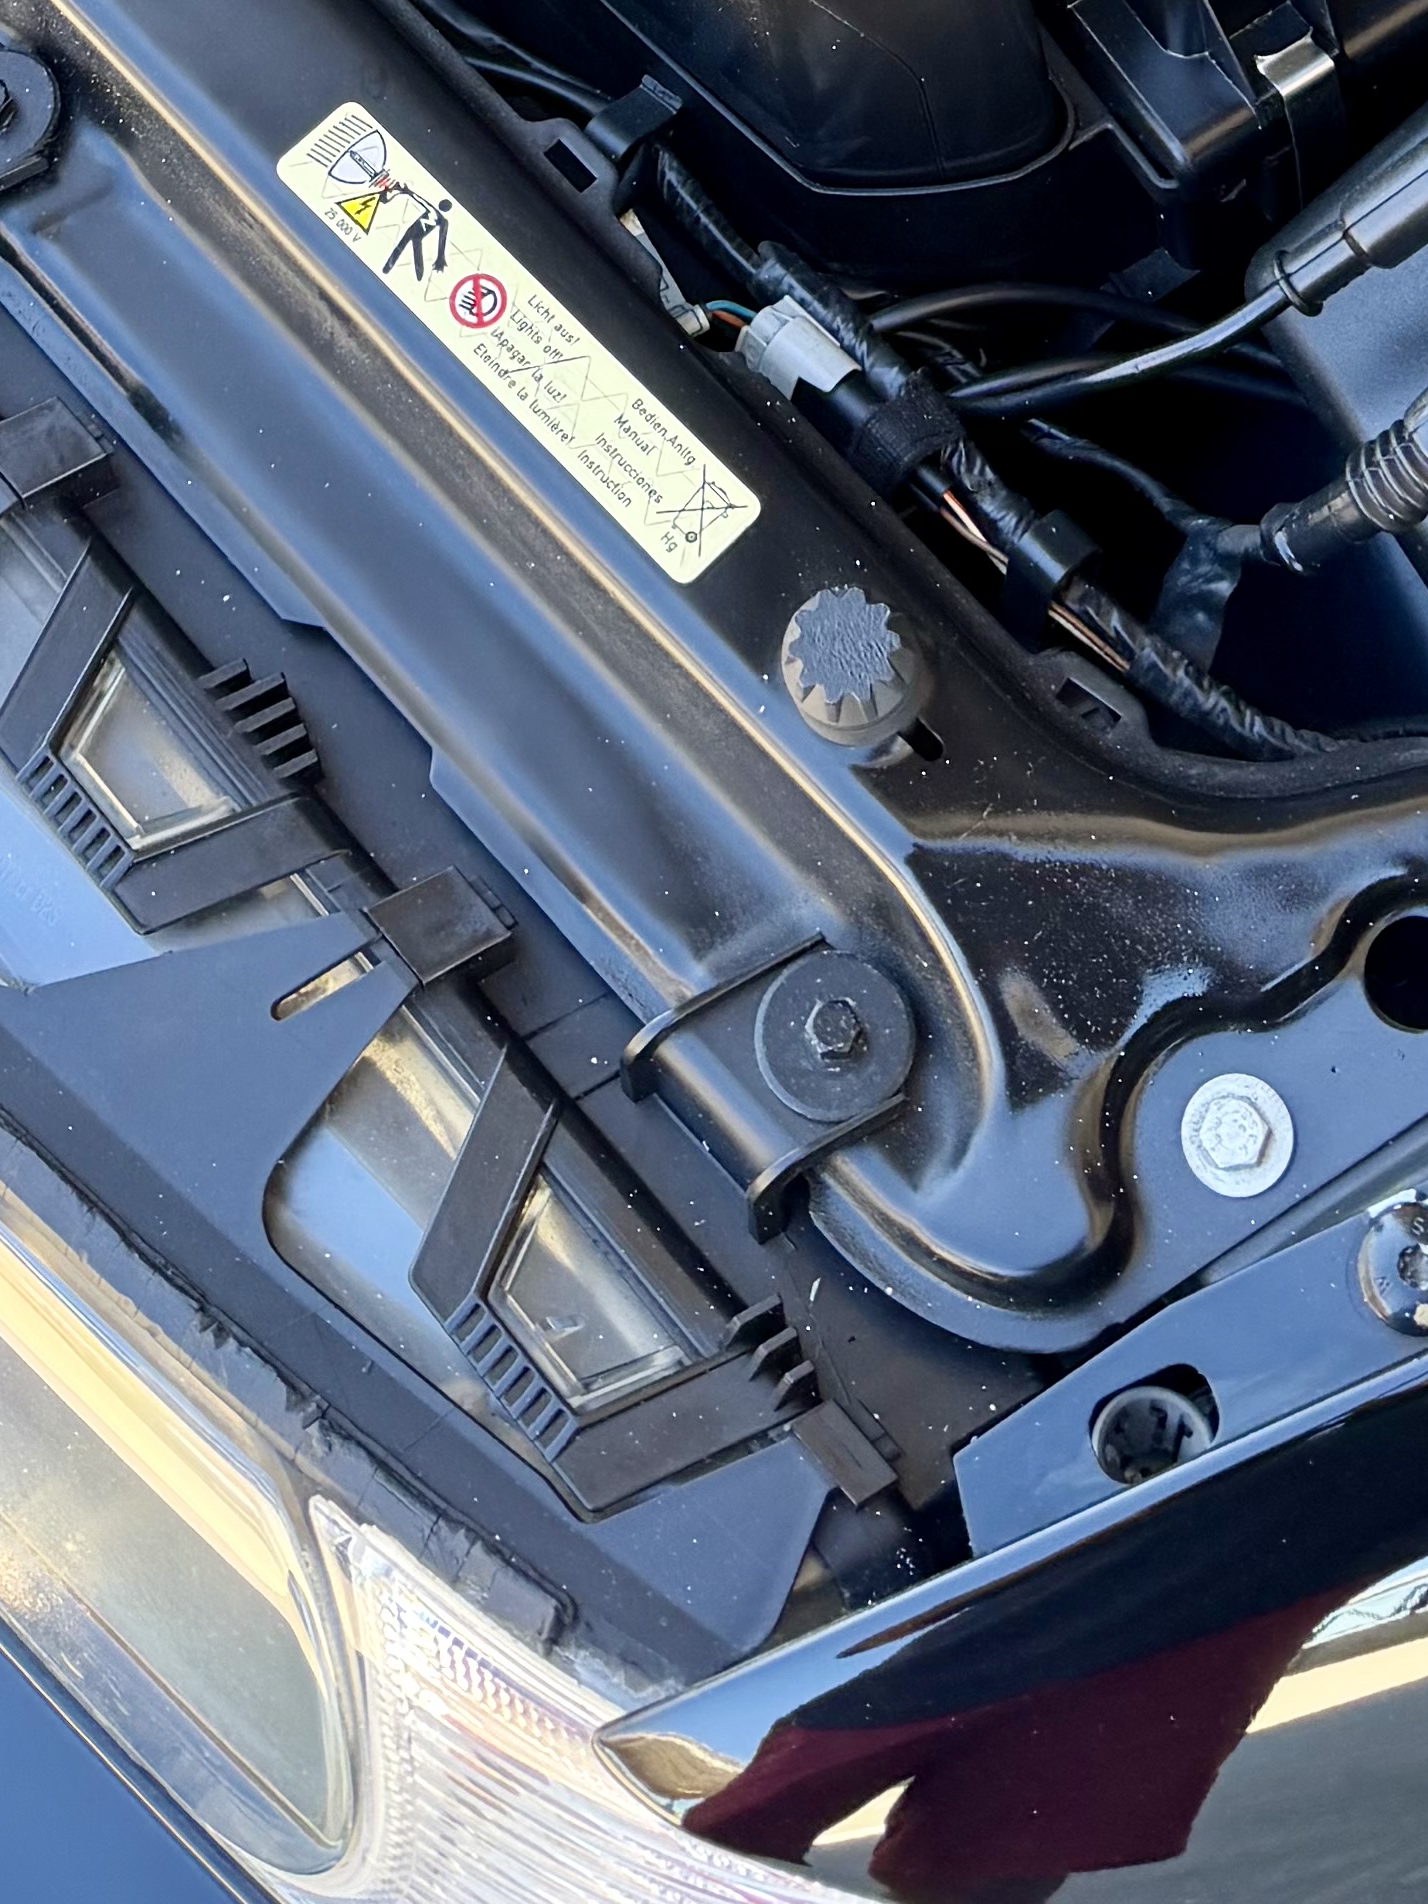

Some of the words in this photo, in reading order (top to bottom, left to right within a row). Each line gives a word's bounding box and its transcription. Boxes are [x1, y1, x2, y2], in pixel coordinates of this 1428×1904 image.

[336, 219, 353, 235] 000
[352, 233, 361, 242] V
[508, 308, 545, 345] Lights
[528, 294, 555, 323] Licht
[554, 324, 580, 343] aus!
[472, 342, 519, 389] Eteindre
[517, 387, 528, 401] la
[530, 367, 546, 383] la
[544, 381, 567, 403] luz!
[614, 413, 656, 456] Manual
[577, 449, 635, 507] Instruction
[594, 432, 666, 504] Instrucciones
[661, 531, 678, 553] Hg
